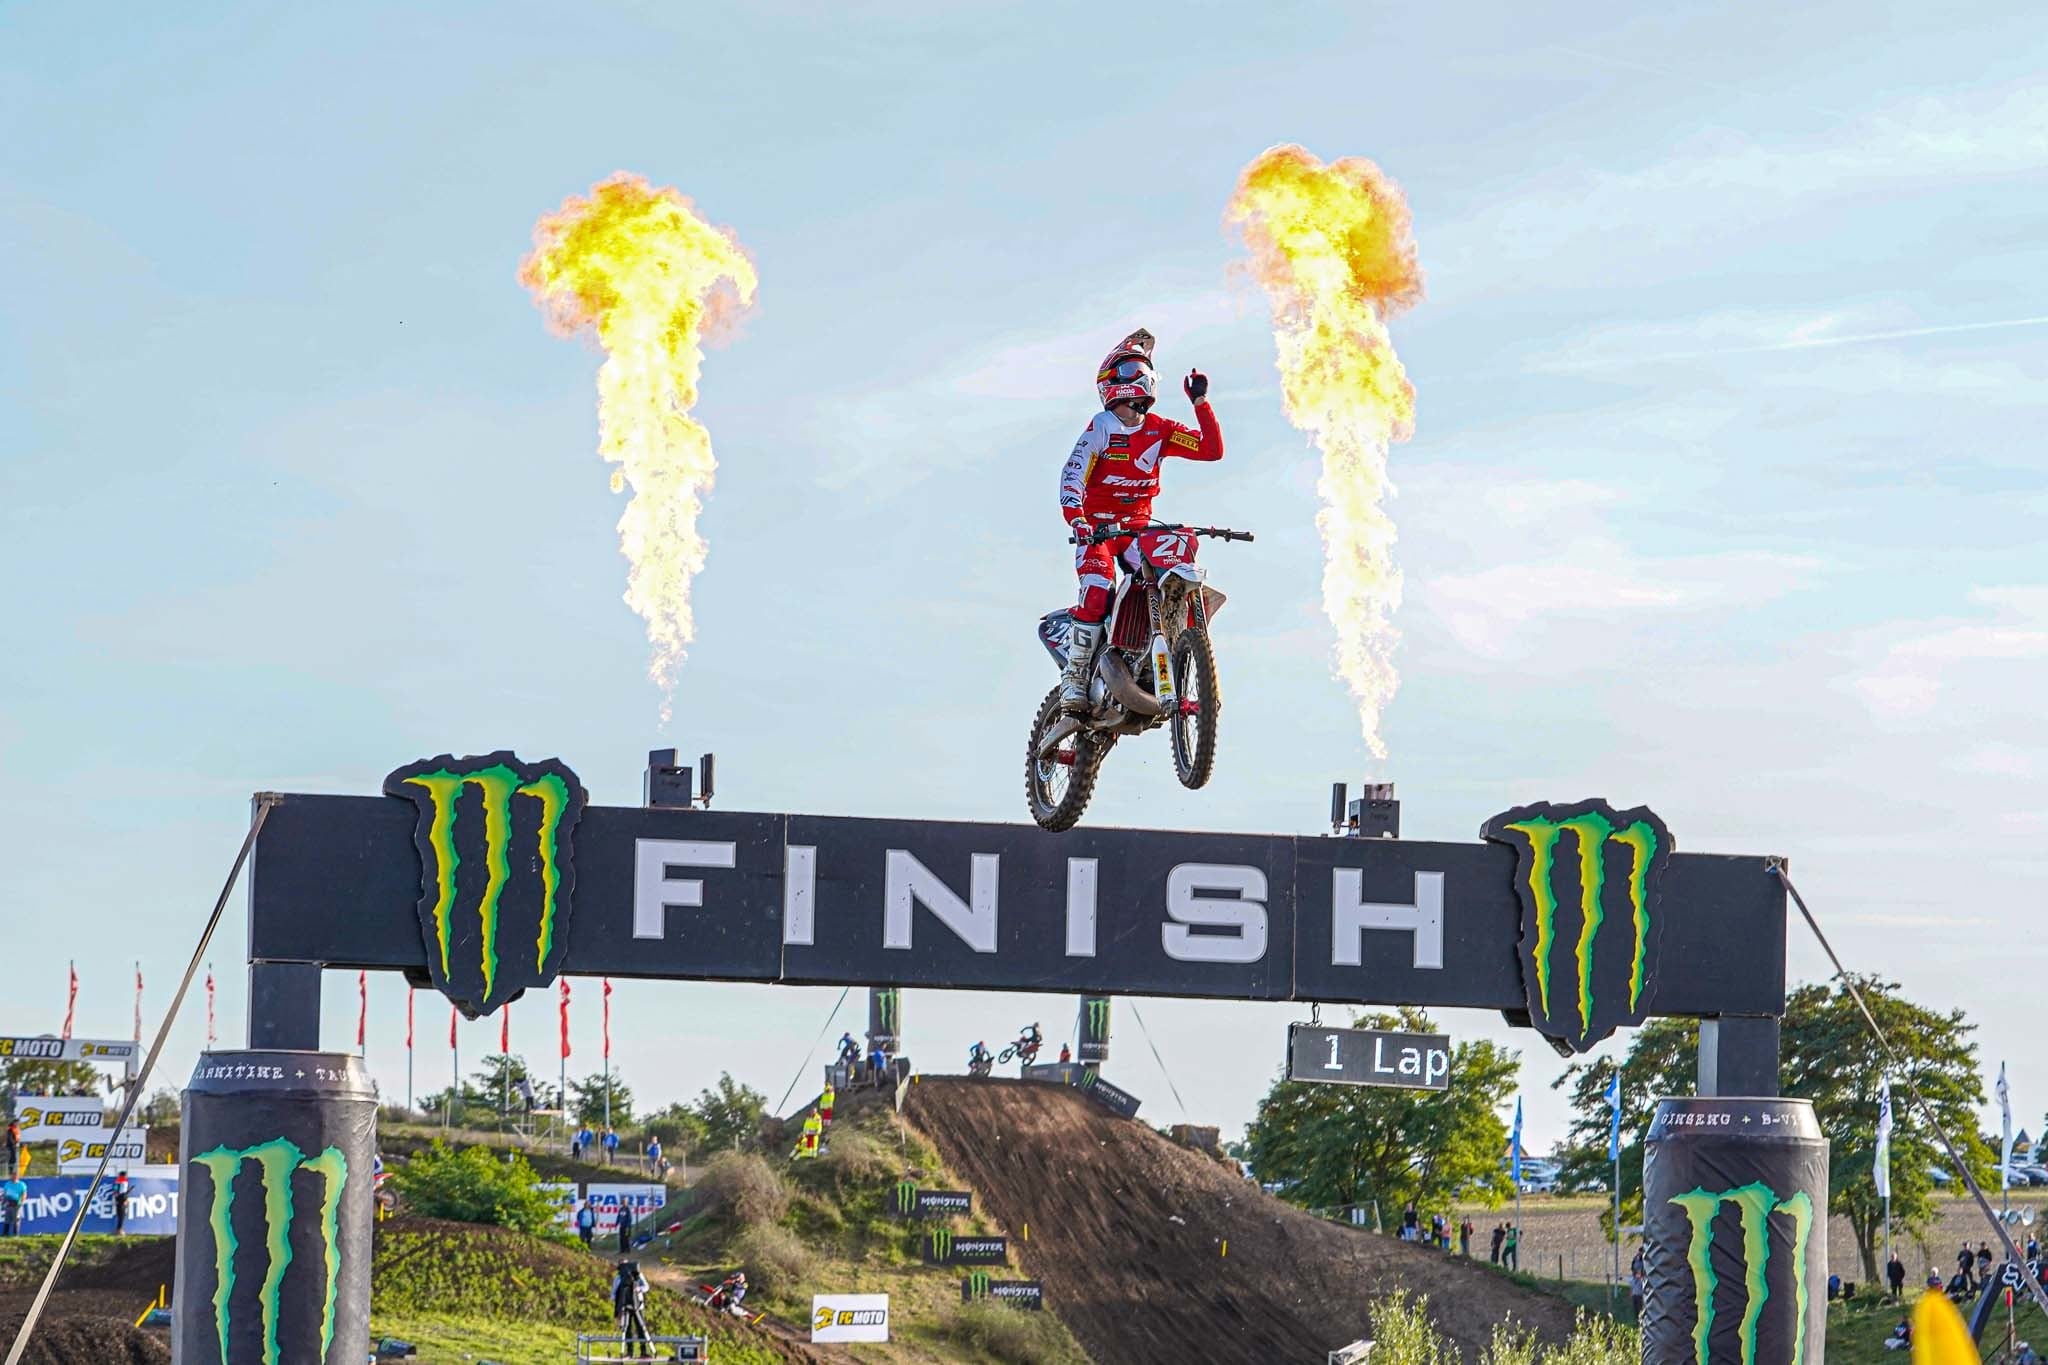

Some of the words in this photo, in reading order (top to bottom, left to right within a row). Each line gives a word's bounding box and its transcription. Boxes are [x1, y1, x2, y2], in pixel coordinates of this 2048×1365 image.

[1152, 534, 1189, 557] 21
[632, 838, 1446, 970] FINISH
[1323, 1034, 1344, 1071] 1
[1374, 1036, 1448, 1086] Lap
[74, 1189, 167, 1219] TRETINO
[920, 1196, 969, 1207] MONSTER
[955, 1242, 1004, 1252] MONSTER
[993, 1287, 1039, 1297] MONSTER
